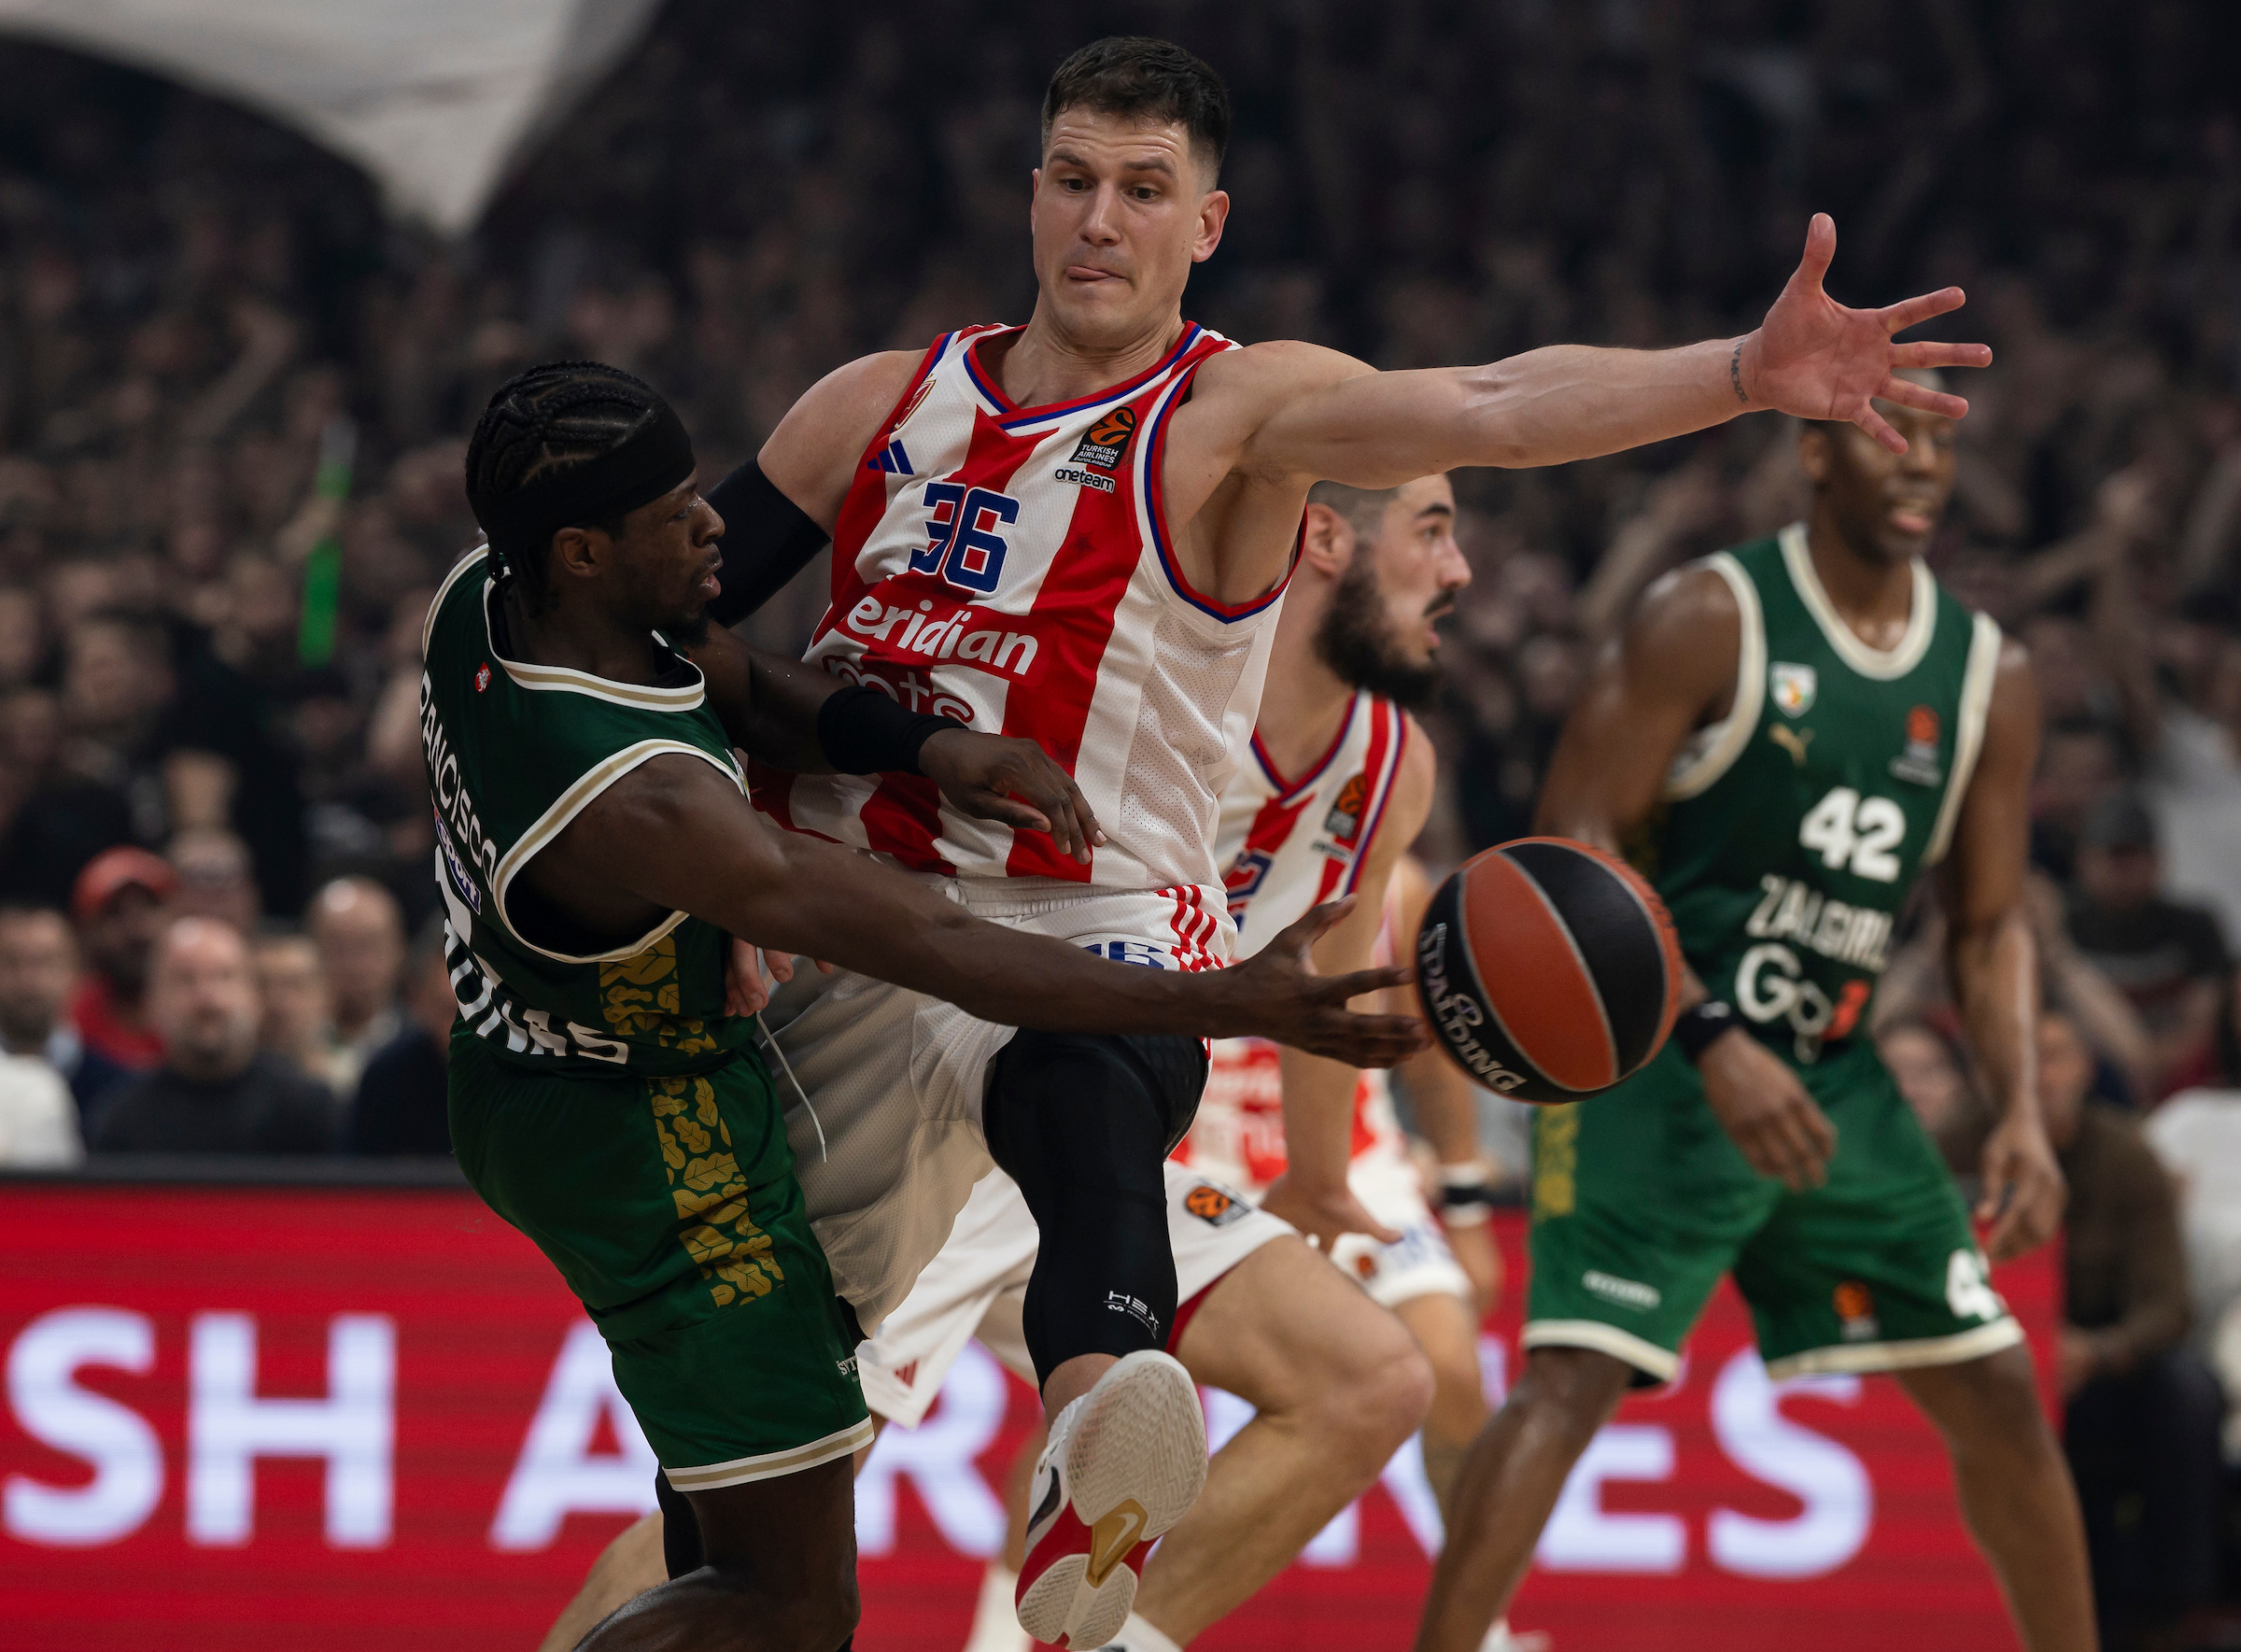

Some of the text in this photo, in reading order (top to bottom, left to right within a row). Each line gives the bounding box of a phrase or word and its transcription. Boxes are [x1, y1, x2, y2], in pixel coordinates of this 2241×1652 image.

[1054, 469, 1115, 492] oneteam
[1077, 450, 1116, 464] AIRLINES
[1081, 445, 1119, 458] TURKISH
[907, 481, 1020, 595] 36
[847, 595, 1038, 676] eridian
[1799, 786, 1906, 882] 42
[1420, 922, 1528, 1094] SPALDING
[4, 1306, 396, 1548] SH
